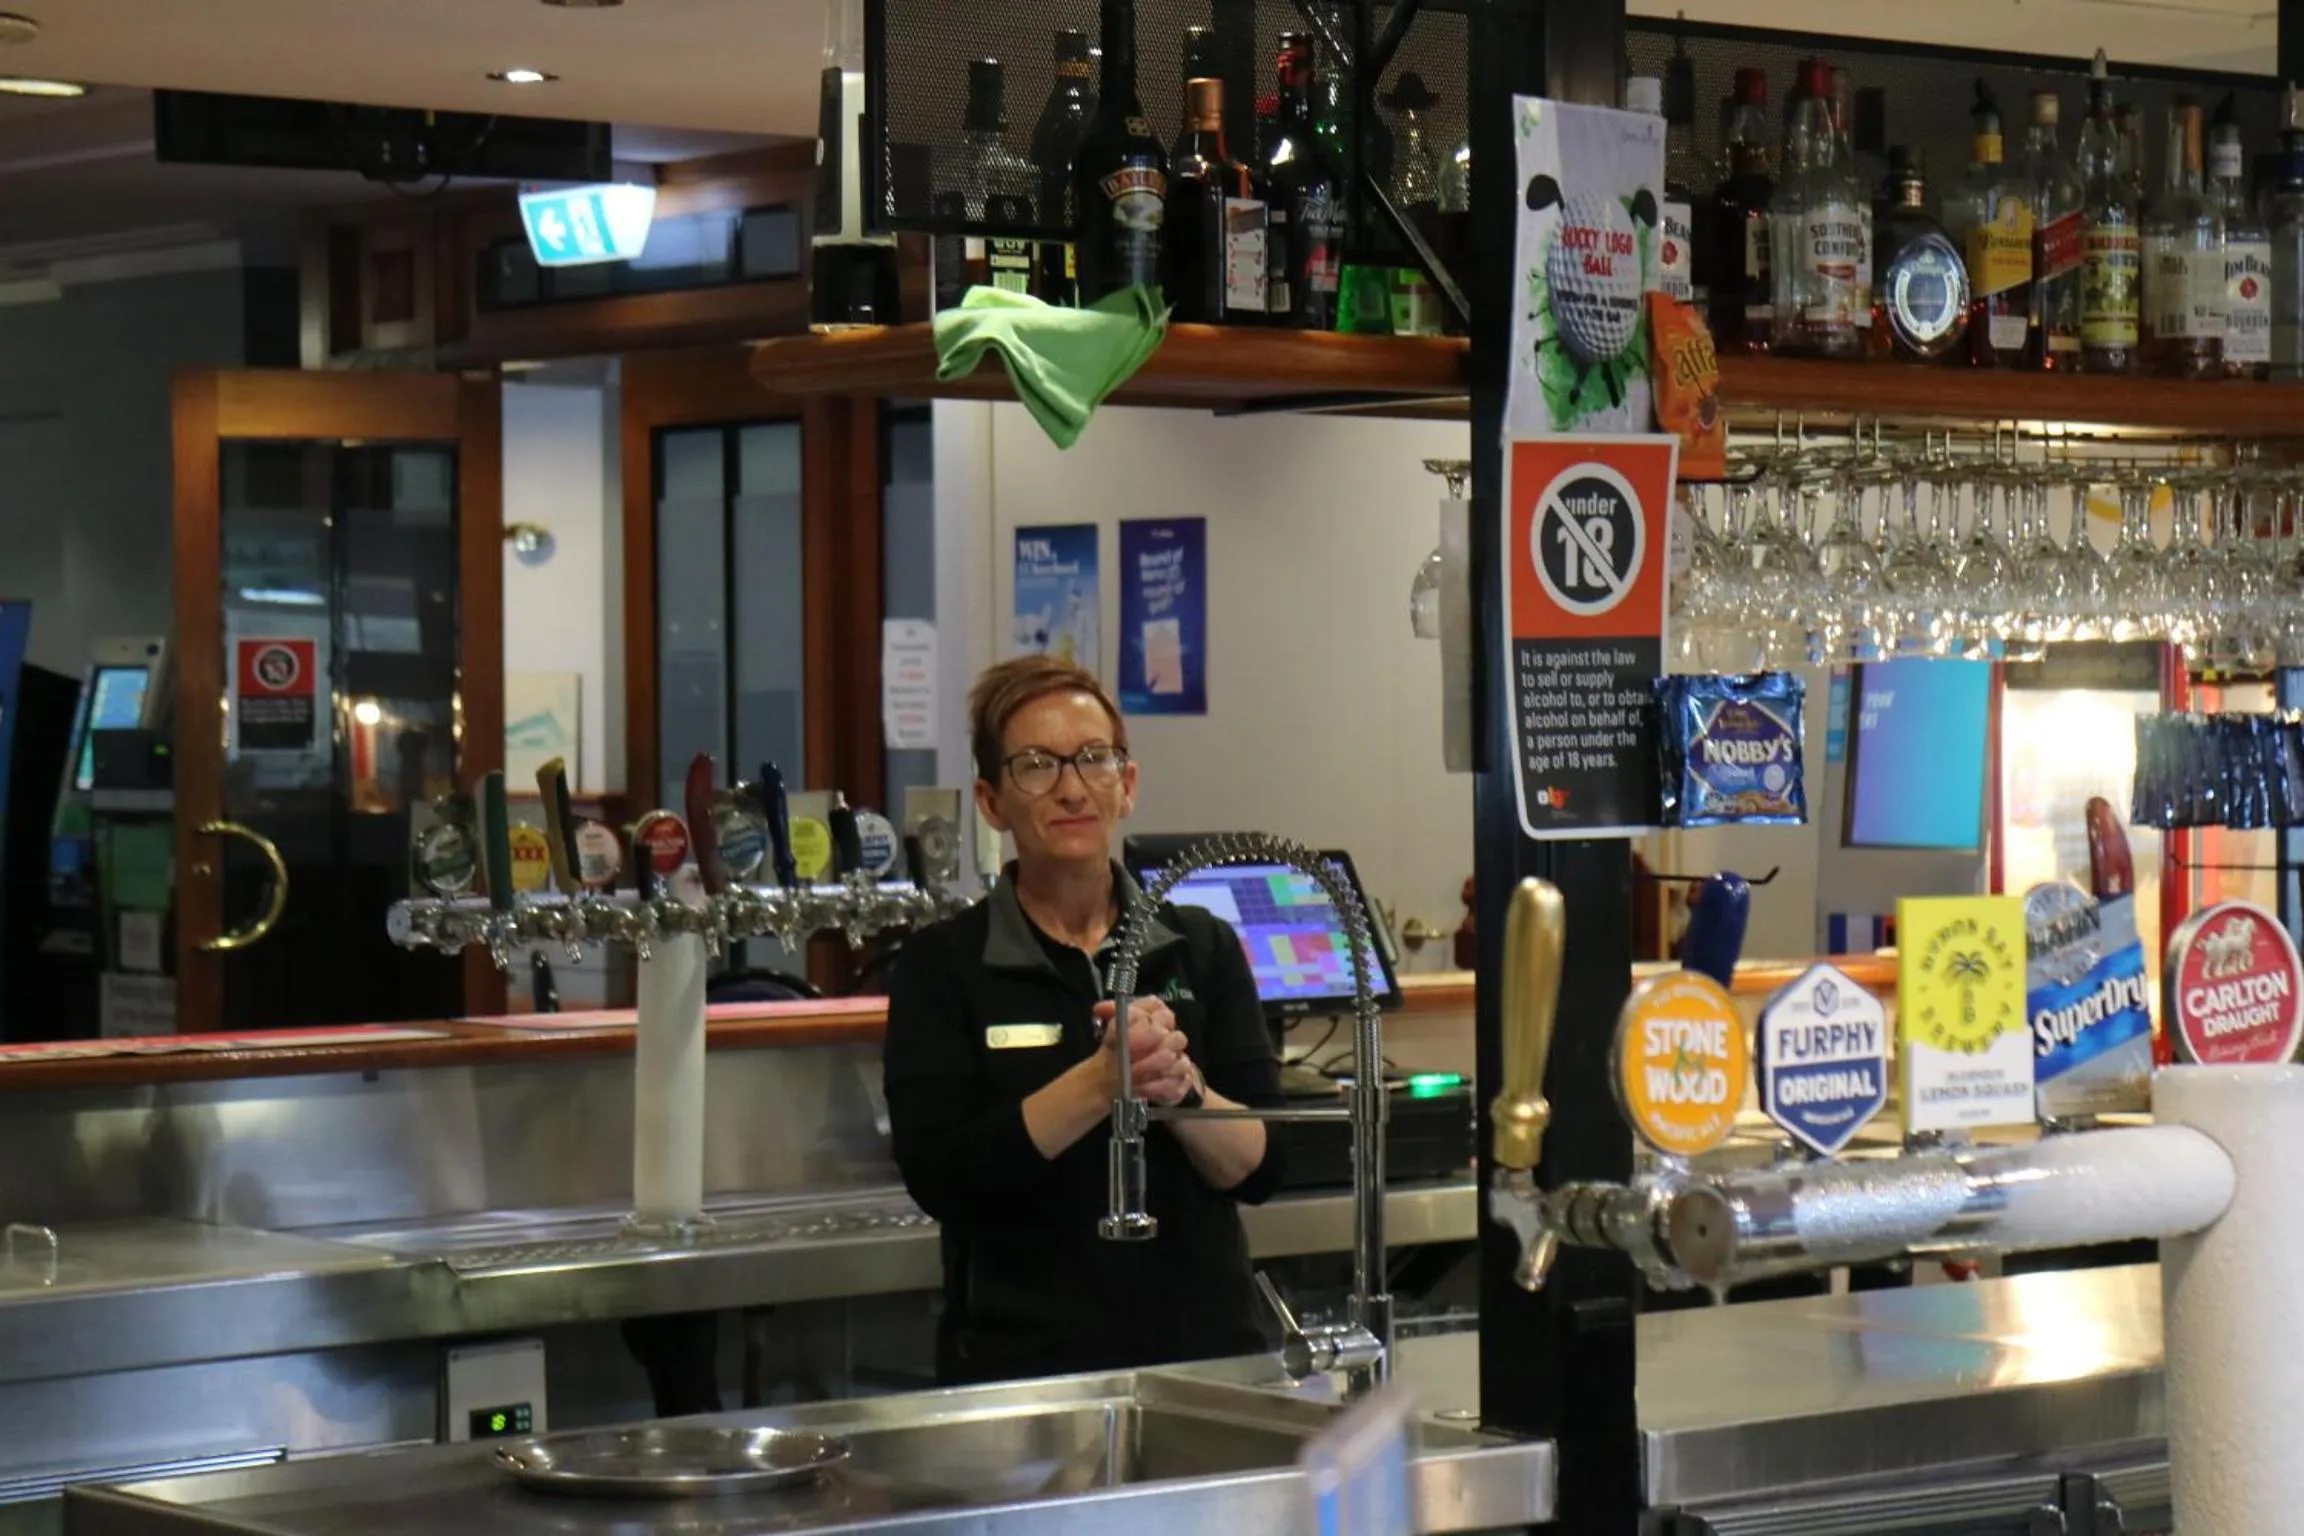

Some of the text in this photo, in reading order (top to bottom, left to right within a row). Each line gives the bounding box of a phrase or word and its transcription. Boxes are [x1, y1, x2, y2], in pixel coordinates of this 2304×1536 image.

[1562, 224, 1633, 254] LUCKY LOGO
[1583, 255, 1612, 277] BALL
[1565, 491, 1618, 517] under
[1557, 516, 1615, 588] 18
[1521, 649, 1636, 670] It is against the law
[1521, 670, 1615, 690] to sell or supply
[1523, 690, 1568, 708] alcohol
[1570, 691, 1586, 708] to,
[1588, 694, 1600, 707] or
[1603, 691, 1615, 706] to
[1525, 709, 1644, 729] alcohol on behalf of,
[1526, 731, 1637, 751] a person under the
[1702, 734, 1793, 764] NOBBY'S
[1528, 752, 1618, 773] age of 18 years.
[2186, 970, 2290, 1018] CARLTON
[2034, 972, 2150, 1056] SuperDry
[2203, 1002, 2280, 1038] DRAUGHT
[1645, 1019, 1729, 1059] STONE
[1779, 1021, 1878, 1060] FURPHY
[1645, 1065, 1729, 1104] WOOD
[1779, 1069, 1878, 1105] ORIGINAL
[1919, 1082, 2029, 1103] LEMON SQUASH
